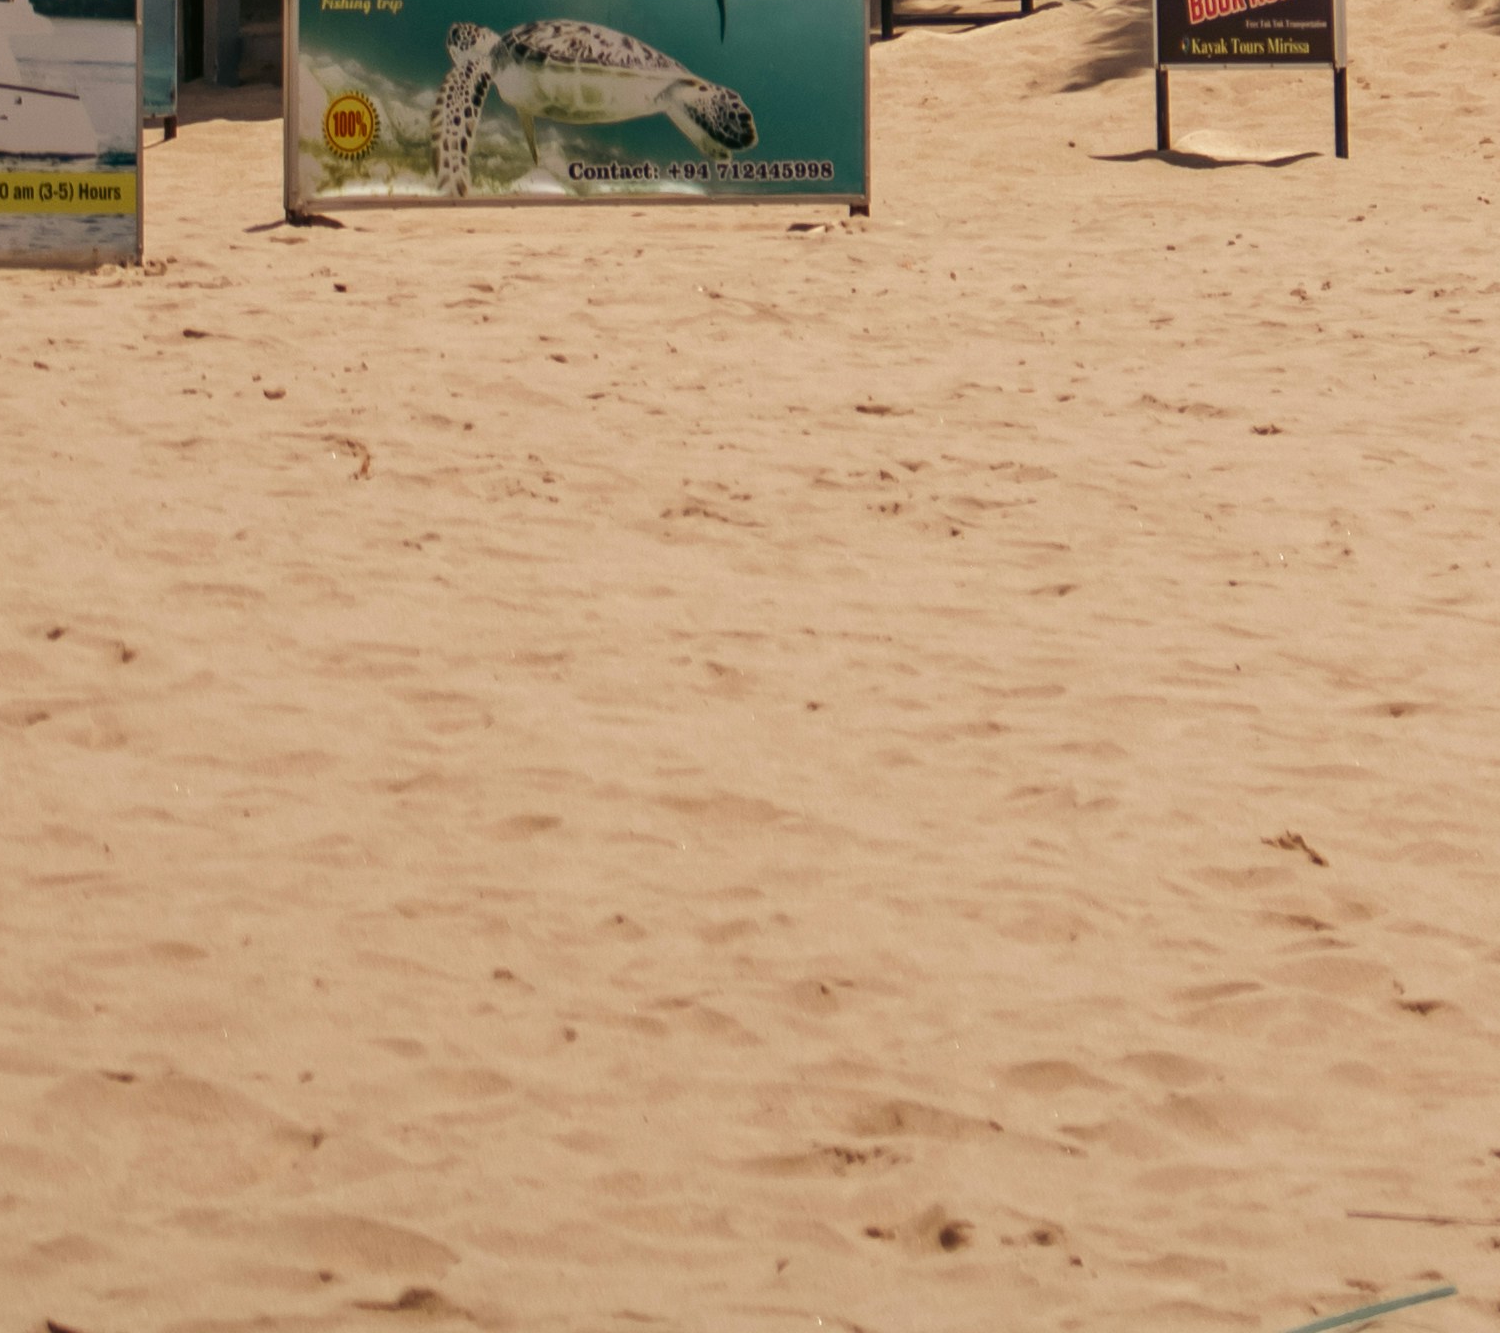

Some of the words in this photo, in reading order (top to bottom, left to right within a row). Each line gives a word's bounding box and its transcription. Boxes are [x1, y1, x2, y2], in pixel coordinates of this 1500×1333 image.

[332, 111, 368, 137] 100%
[568, 162, 659, 180] Contact:
[666, 164, 709, 180] +94
[716, 162, 834, 180] 712445998
[13, 188, 34, 199] am
[39, 182, 74, 201] (3-5)
[79, 183, 121, 200] Hours
